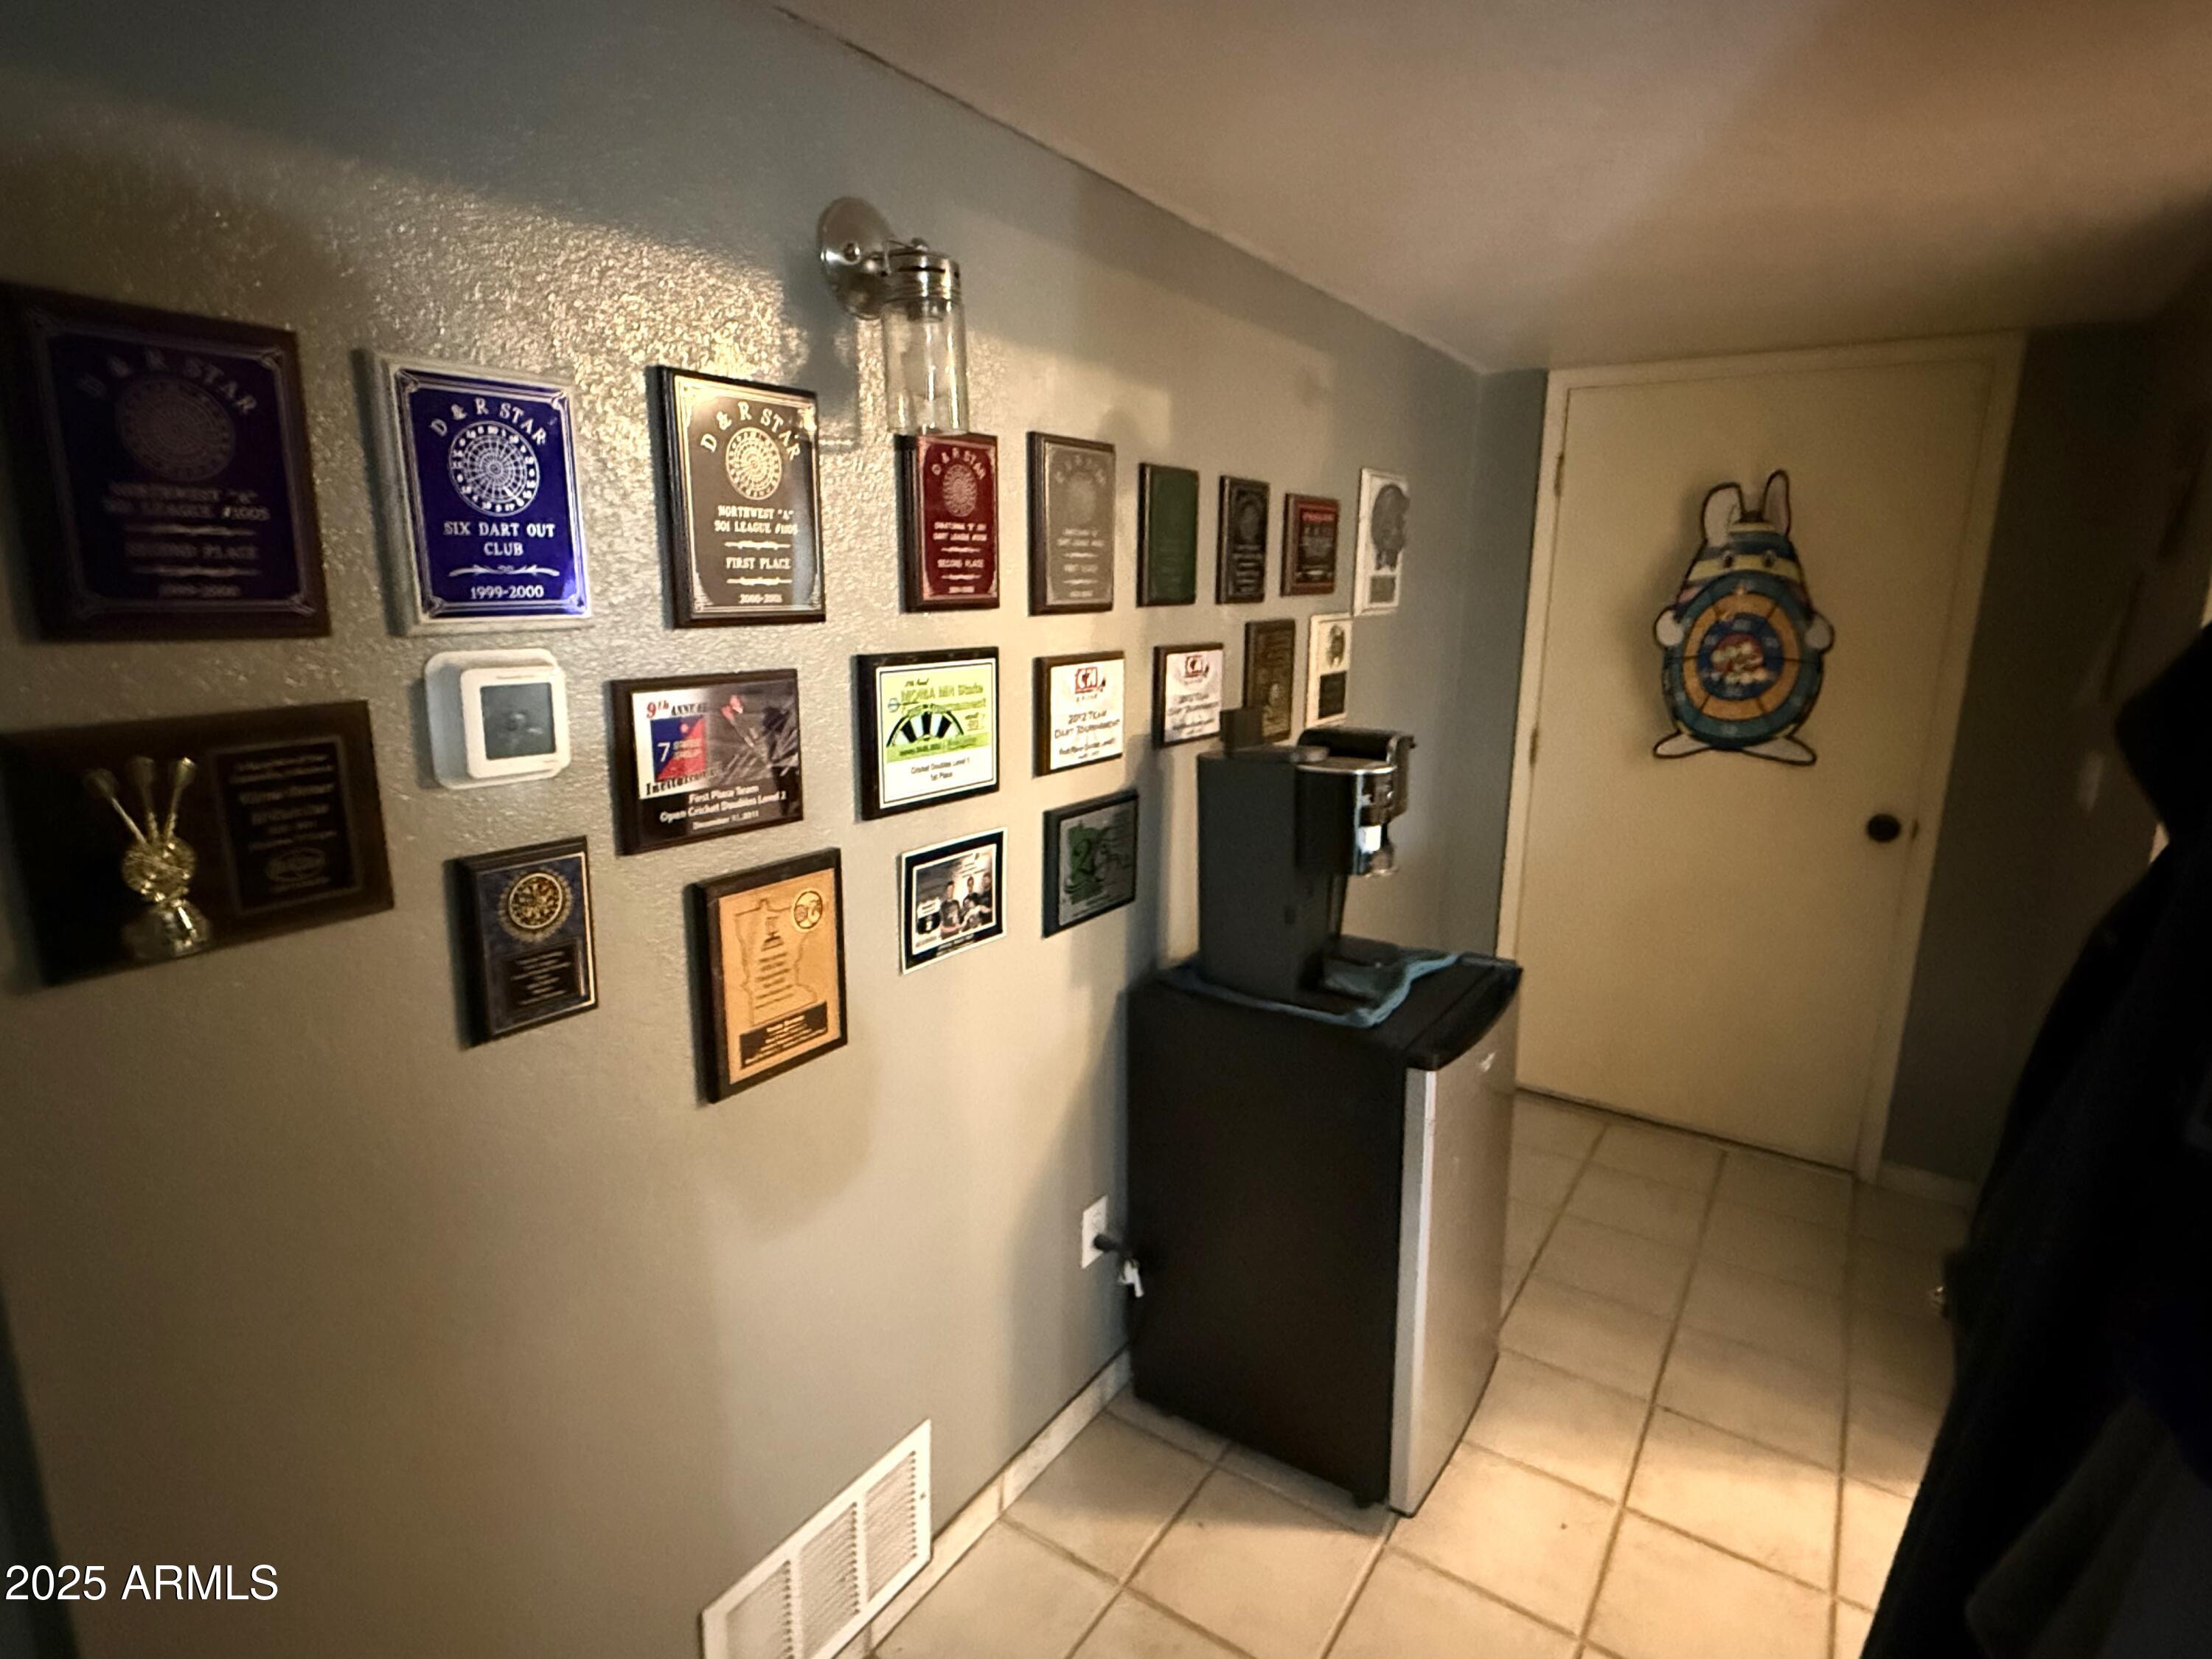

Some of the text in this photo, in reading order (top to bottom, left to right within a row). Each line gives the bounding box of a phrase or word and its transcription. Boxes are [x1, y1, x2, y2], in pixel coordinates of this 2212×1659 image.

[184, 359, 258, 416] STAR
[428, 398, 548, 446] D & R STAR
[700, 401, 801, 462] D & R STAR
[717, 505, 775, 519] NORTHWEST
[443, 521, 556, 538] SIX DART OUT
[714, 520, 730, 532] 501
[734, 521, 772, 534] LEAGUE
[483, 541, 524, 557] CLUB
[726, 556, 791, 570] FIRST PLACE
[470, 585, 544, 601] 1999-2000
[657, 741, 671, 763] 7
[689, 785, 759, 805] First Place Team
[659, 810, 687, 824] Open
[687, 803, 720, 817] Cricket
[720, 797, 757, 811] Doubles
[757, 791, 780, 804] Level
